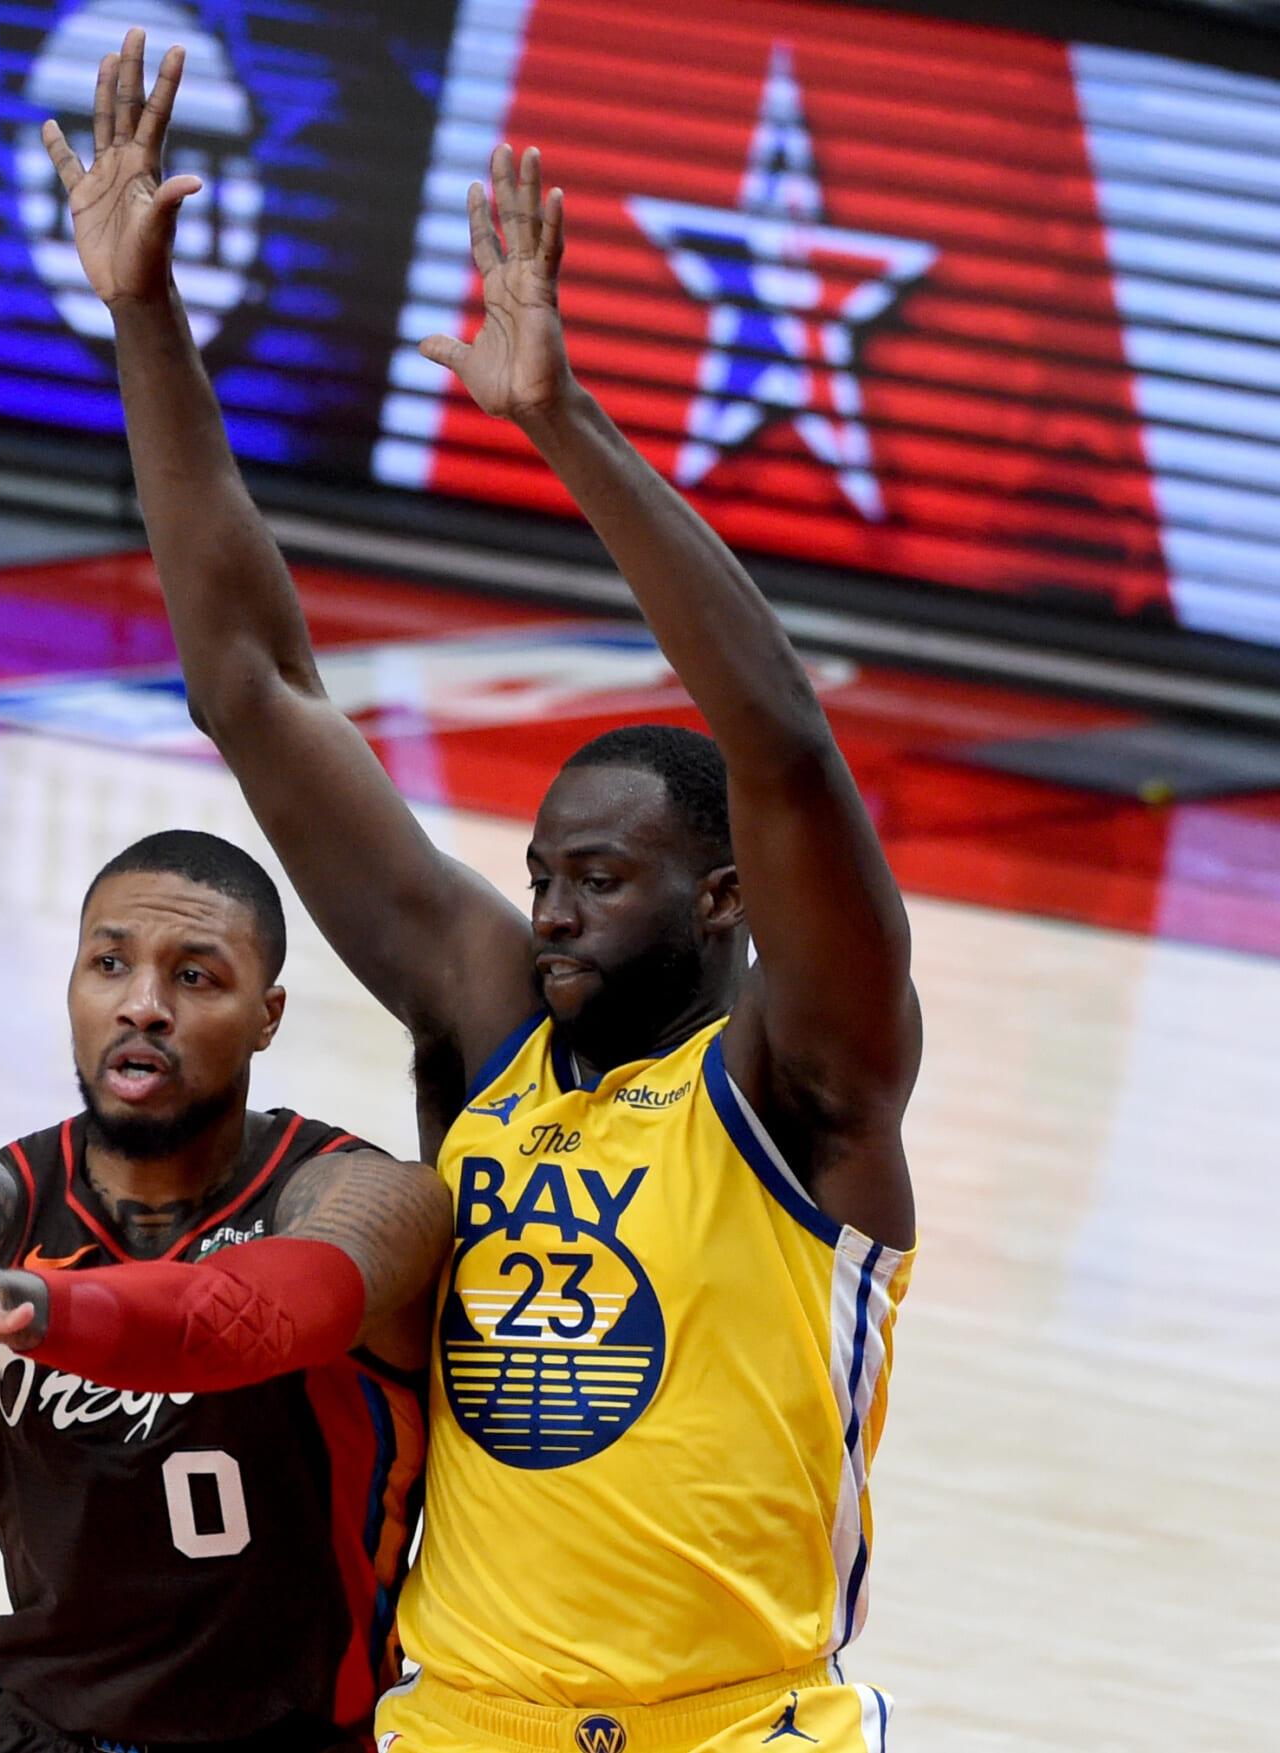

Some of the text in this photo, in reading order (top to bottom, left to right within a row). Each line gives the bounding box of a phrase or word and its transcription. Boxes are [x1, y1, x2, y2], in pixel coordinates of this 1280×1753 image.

[613, 1081, 691, 1107] Rakuten
[519, 1122, 582, 1156] The
[455, 1156, 650, 1243] BAY
[495, 1252, 596, 1339] 23
[162, 1449, 251, 1559] 0
[578, 1727, 622, 1753] W
